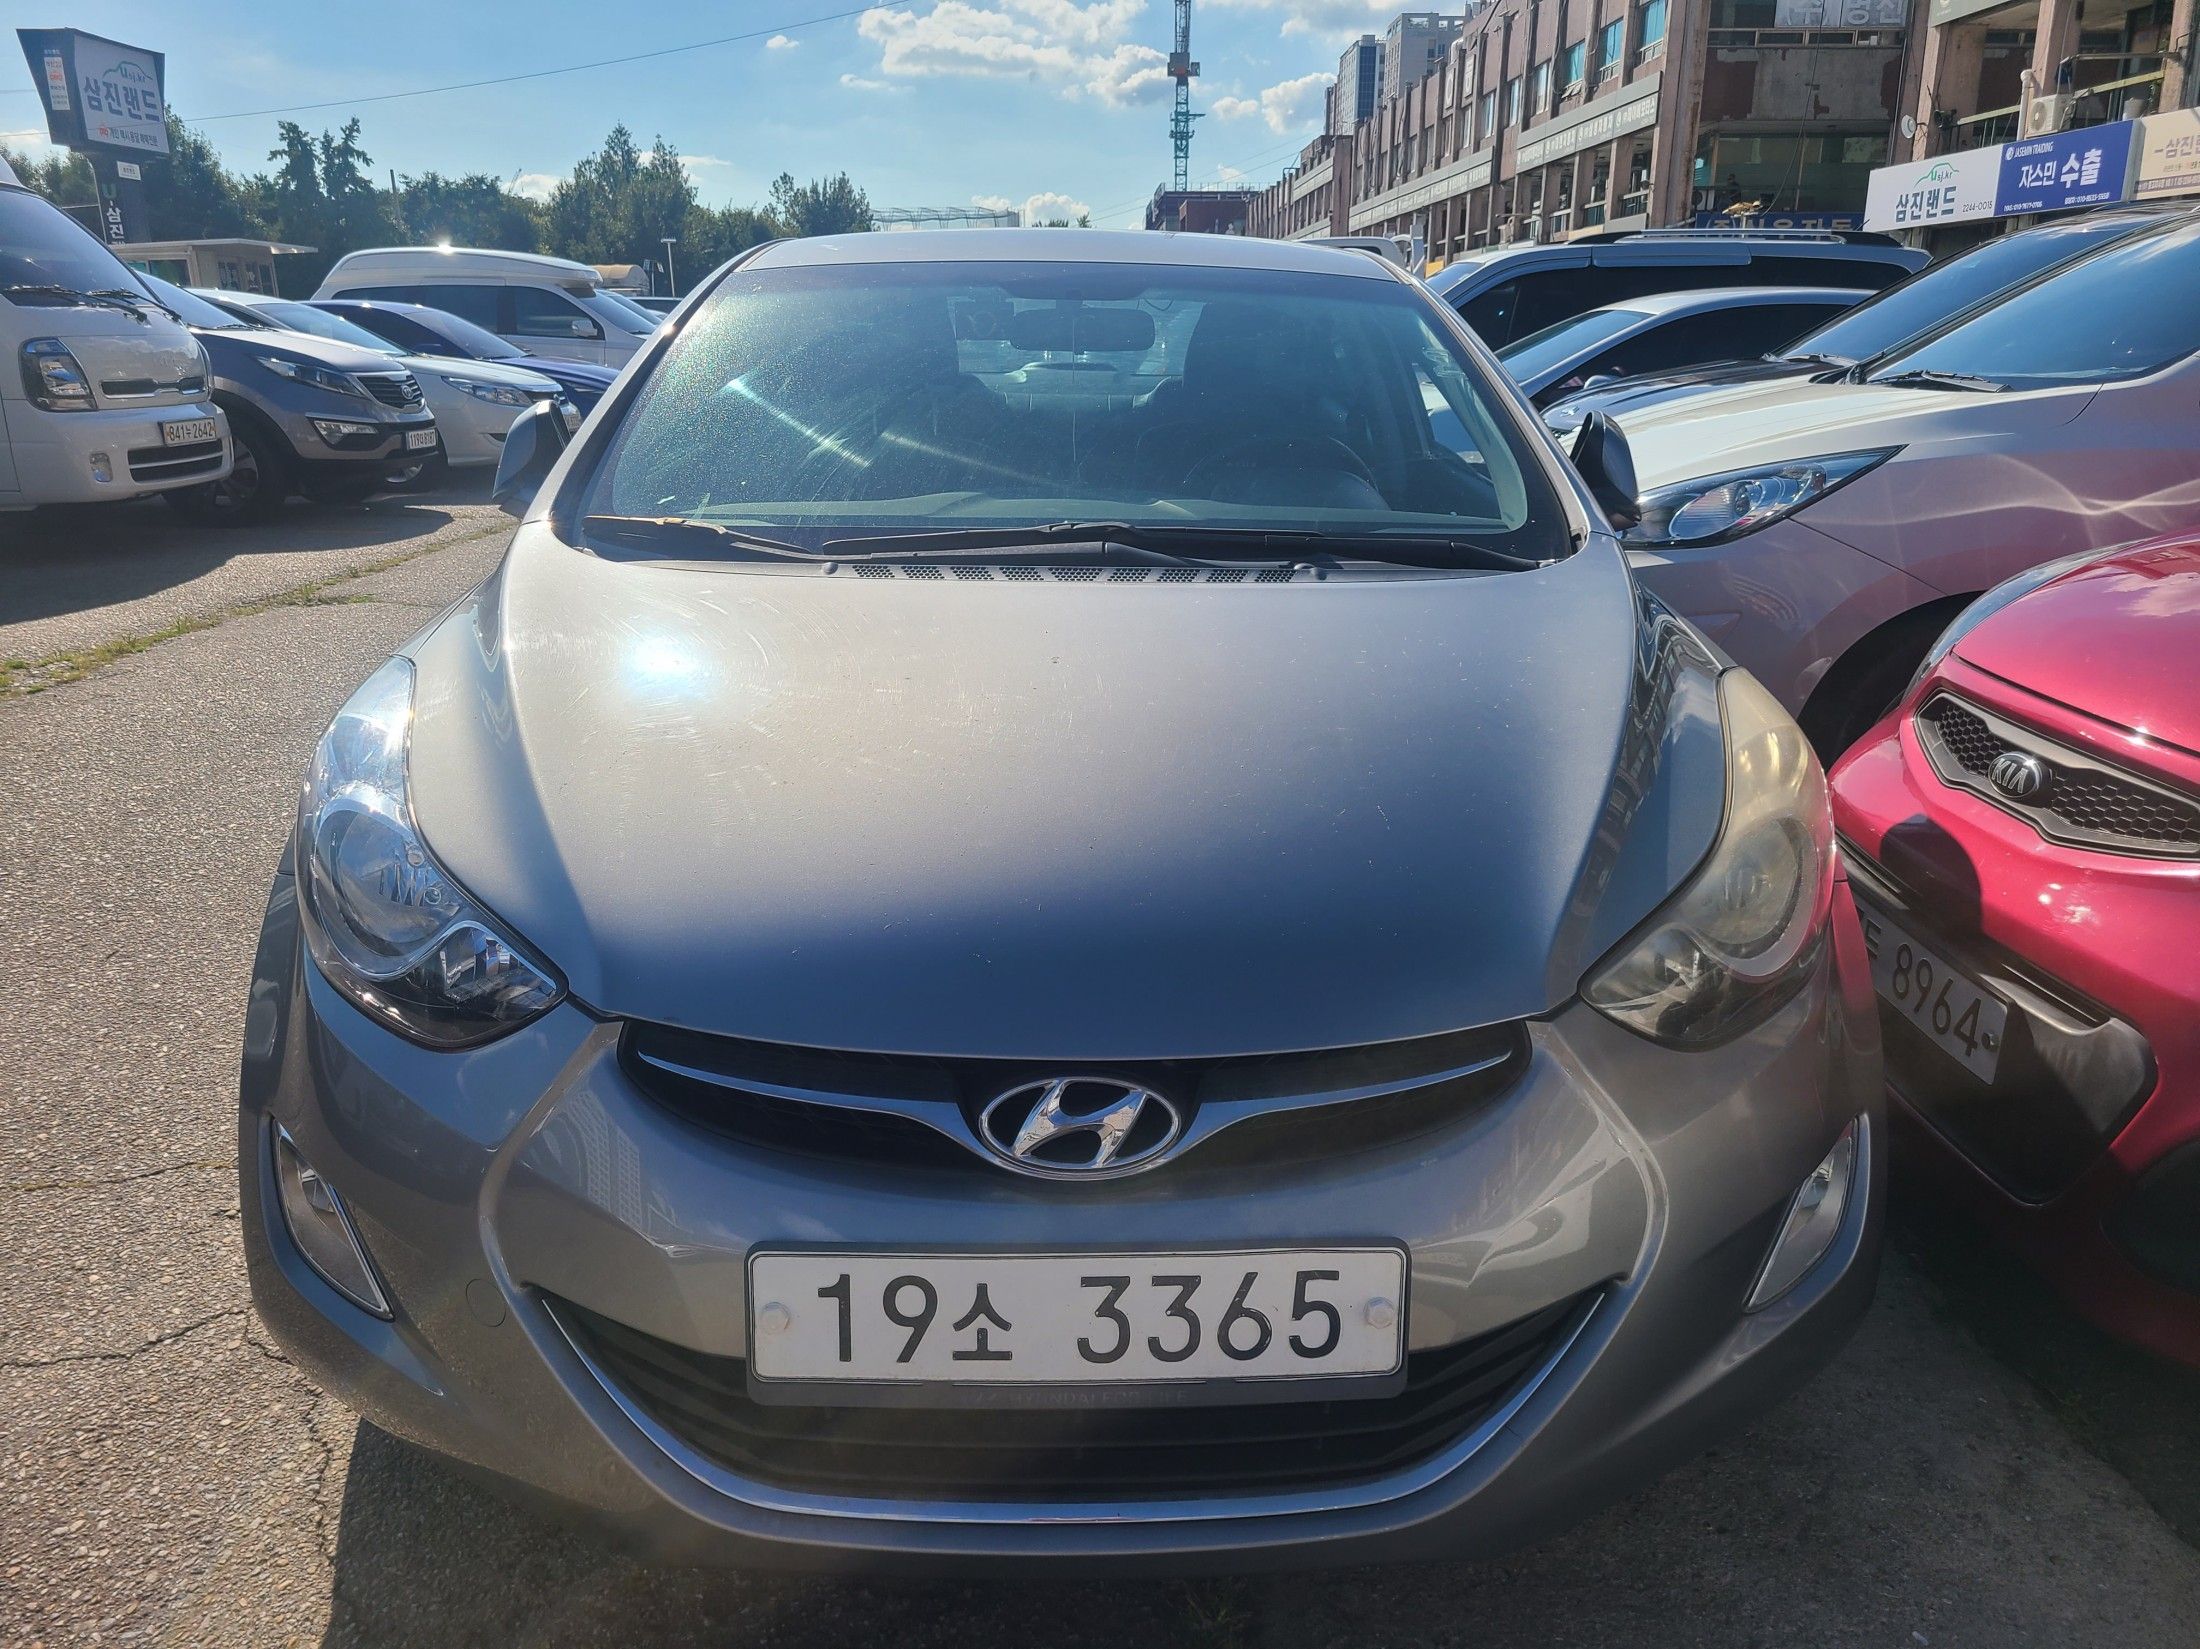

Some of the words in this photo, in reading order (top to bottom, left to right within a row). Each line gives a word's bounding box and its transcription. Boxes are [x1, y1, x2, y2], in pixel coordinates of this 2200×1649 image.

[84, 76, 160, 122] 삼진랜드
[2060, 148, 2103, 189] 수출
[1895, 186, 1957, 222] 삼진랜드
[1893, 944, 1982, 1057] 8964
[817, 1273, 1013, 1362] 19소
[1077, 1270, 1341, 1363] 3365
